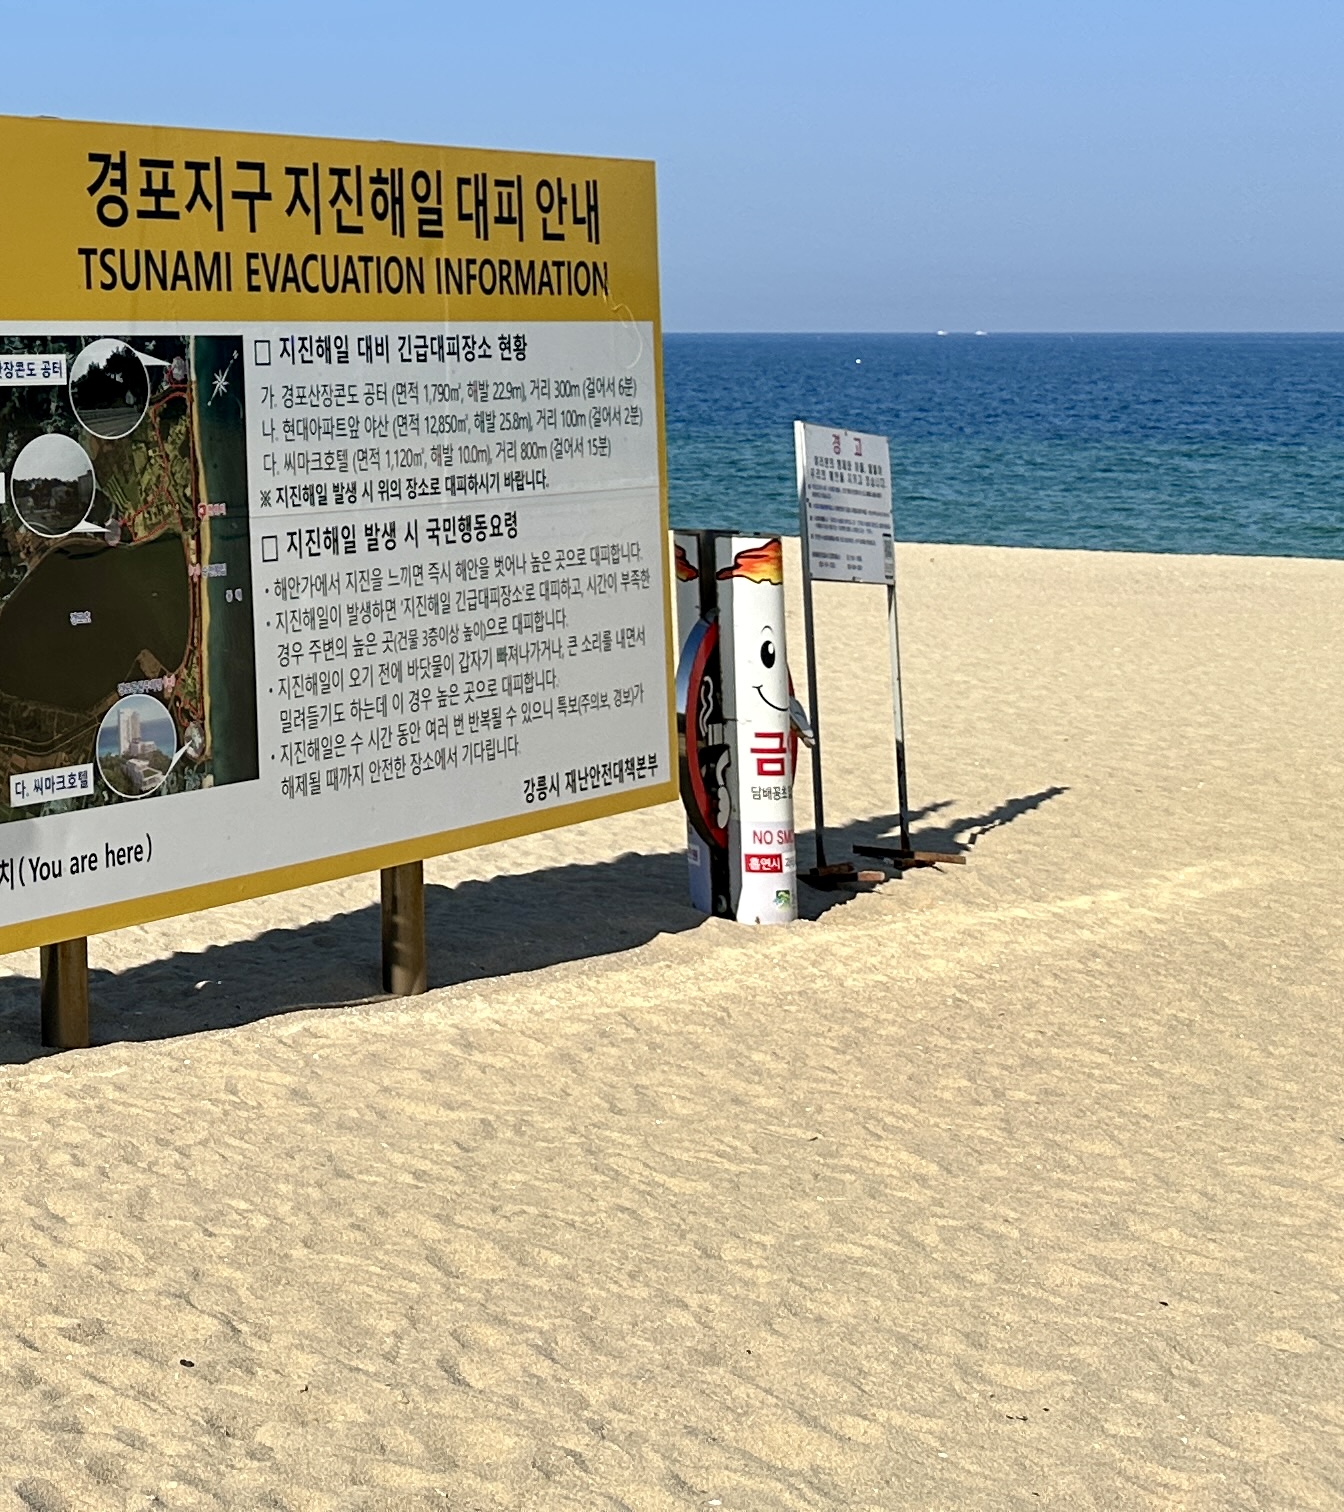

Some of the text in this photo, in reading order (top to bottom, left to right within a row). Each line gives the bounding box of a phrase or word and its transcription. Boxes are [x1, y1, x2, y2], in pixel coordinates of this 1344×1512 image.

[86, 150, 600, 245] 경포지구 지진해일 대피 안내
[78, 247, 609, 297] TSUNAMI EVACUATION INFORMATION
[279, 333, 527, 365] 지진해일 대비 긴급대피장소 현황
[40, 359, 63, 378] 공터
[281, 379, 580, 409] 경포산장콘도 공터 300m
[282, 409, 587, 442] 현대아파트앞 야산 100m
[283, 441, 548, 475] 씨마크호텔 800m
[276, 482, 328, 508] 지진해일
[332, 481, 357, 505] 발생
[445, 471, 500, 497] 대피하시기
[286, 510, 518, 559] 지진해일 발생 시 국민행동요령
[274, 564, 424, 602] 해안가에서 지진을 느끼면
[275, 597, 397, 634] 지진해일이 발생하면
[308, 632, 377, 663] 주변의 높은
[750, 731, 787, 777] 금
[33, 769, 89, 796] 씨마크호텔
[523, 752, 659, 804] 강릉시 재난안전대책본부
[753, 829, 773, 844] NO
[70, 850, 98, 875] are
